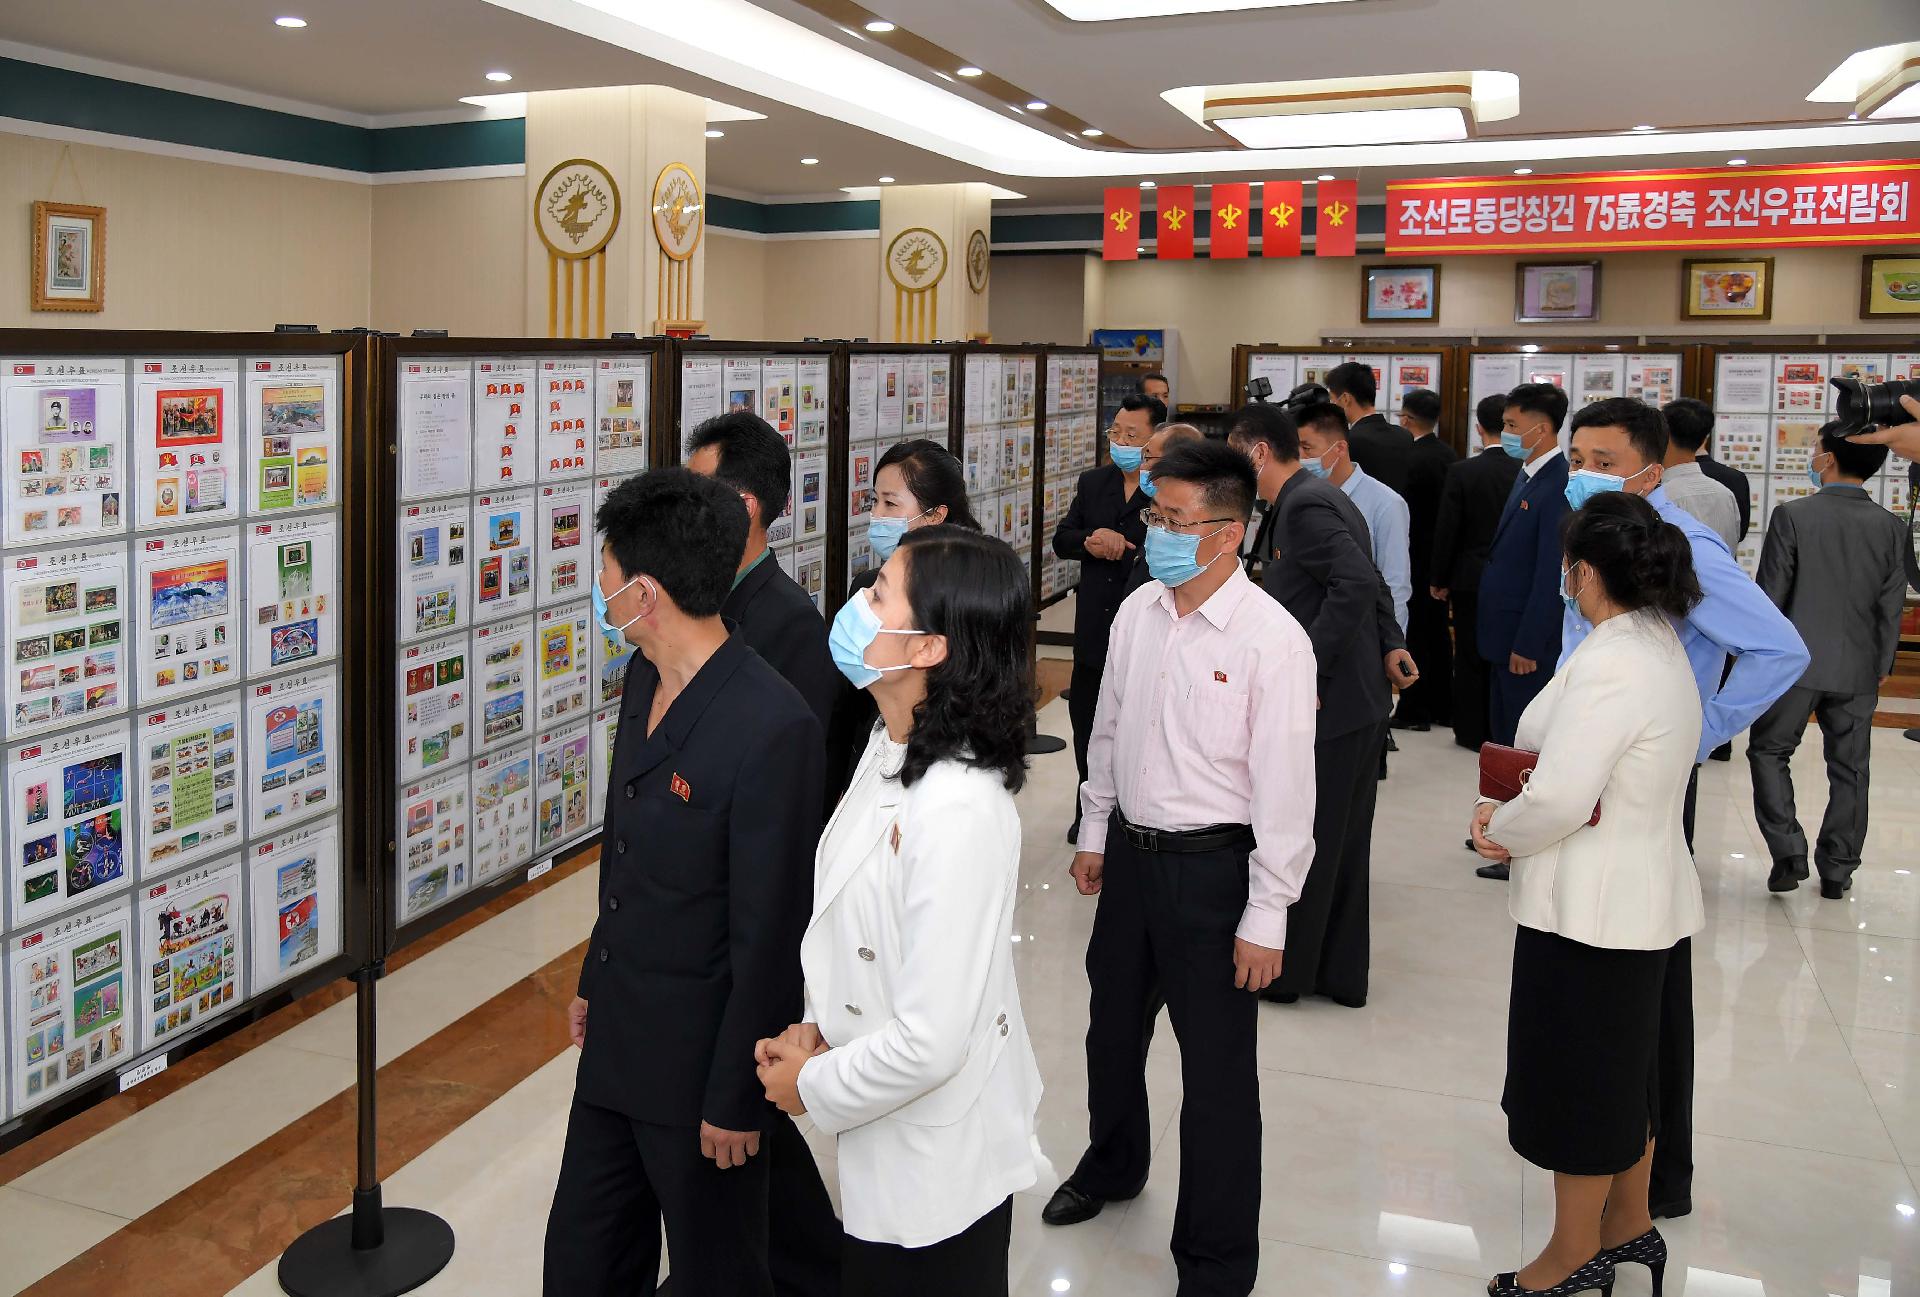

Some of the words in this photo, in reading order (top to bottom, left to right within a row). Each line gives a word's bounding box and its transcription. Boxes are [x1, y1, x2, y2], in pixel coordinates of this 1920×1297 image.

[1398, 194, 1576, 236] 조선로동당창건
[1583, 191, 1697, 232] 75돐경축
[1704, 180, 1909, 228] 조선우표전람회
[44, 364, 87, 376] 조선우표
[170, 364, 205, 373] 조선우표
[172, 535, 207, 549] 조선우표
[48, 552, 88, 567] 조선우표
[174, 703, 209, 719] 조선우표
[51, 734, 92, 753] 조선우표
[175, 869, 209, 889] 조선우표
[53, 915, 93, 938] 조선우표
